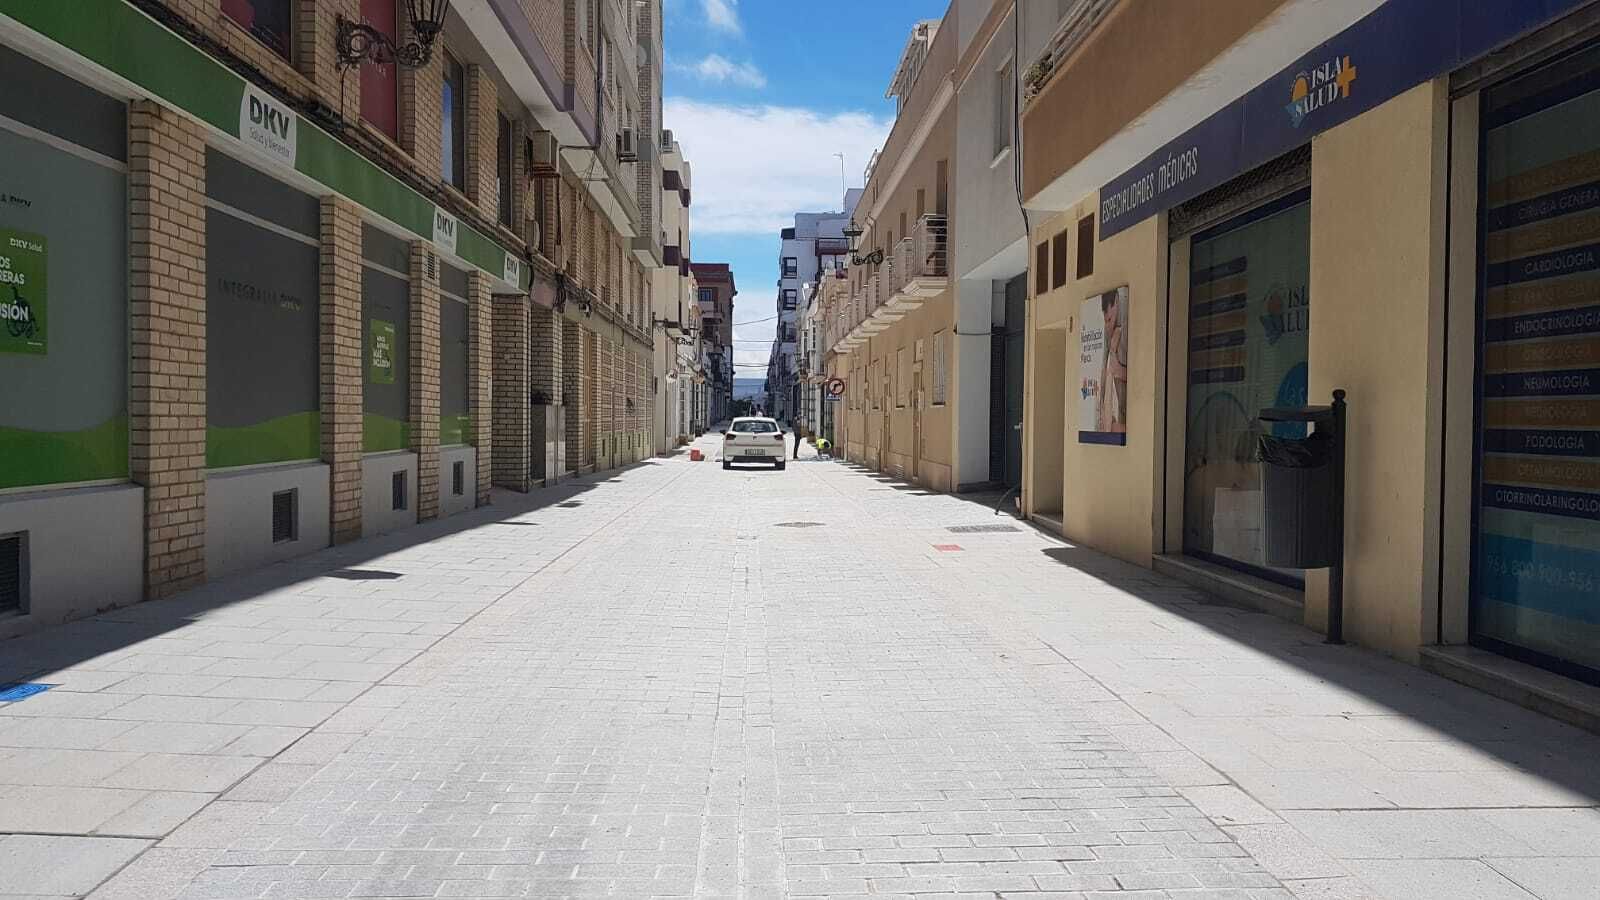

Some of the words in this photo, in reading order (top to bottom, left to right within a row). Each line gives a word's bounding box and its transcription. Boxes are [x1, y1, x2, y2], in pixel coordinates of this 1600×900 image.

[1312, 55, 1341, 89] ISLA
[1295, 82, 1339, 117] SALUD
[250, 95, 289, 139] DKV
[1102, 172, 1154, 224] ESPECIALIDADES
[1157, 147, 1198, 194] MÉDICAS
[1559, 191, 1600, 210] GENERA
[437, 212, 453, 237] DKV
[1288, 284, 1308, 308] ISL
[1525, 435, 1585, 451] PODOLOGIA
[1495, 488, 1600, 513] OTORRINOLARINGOLO
